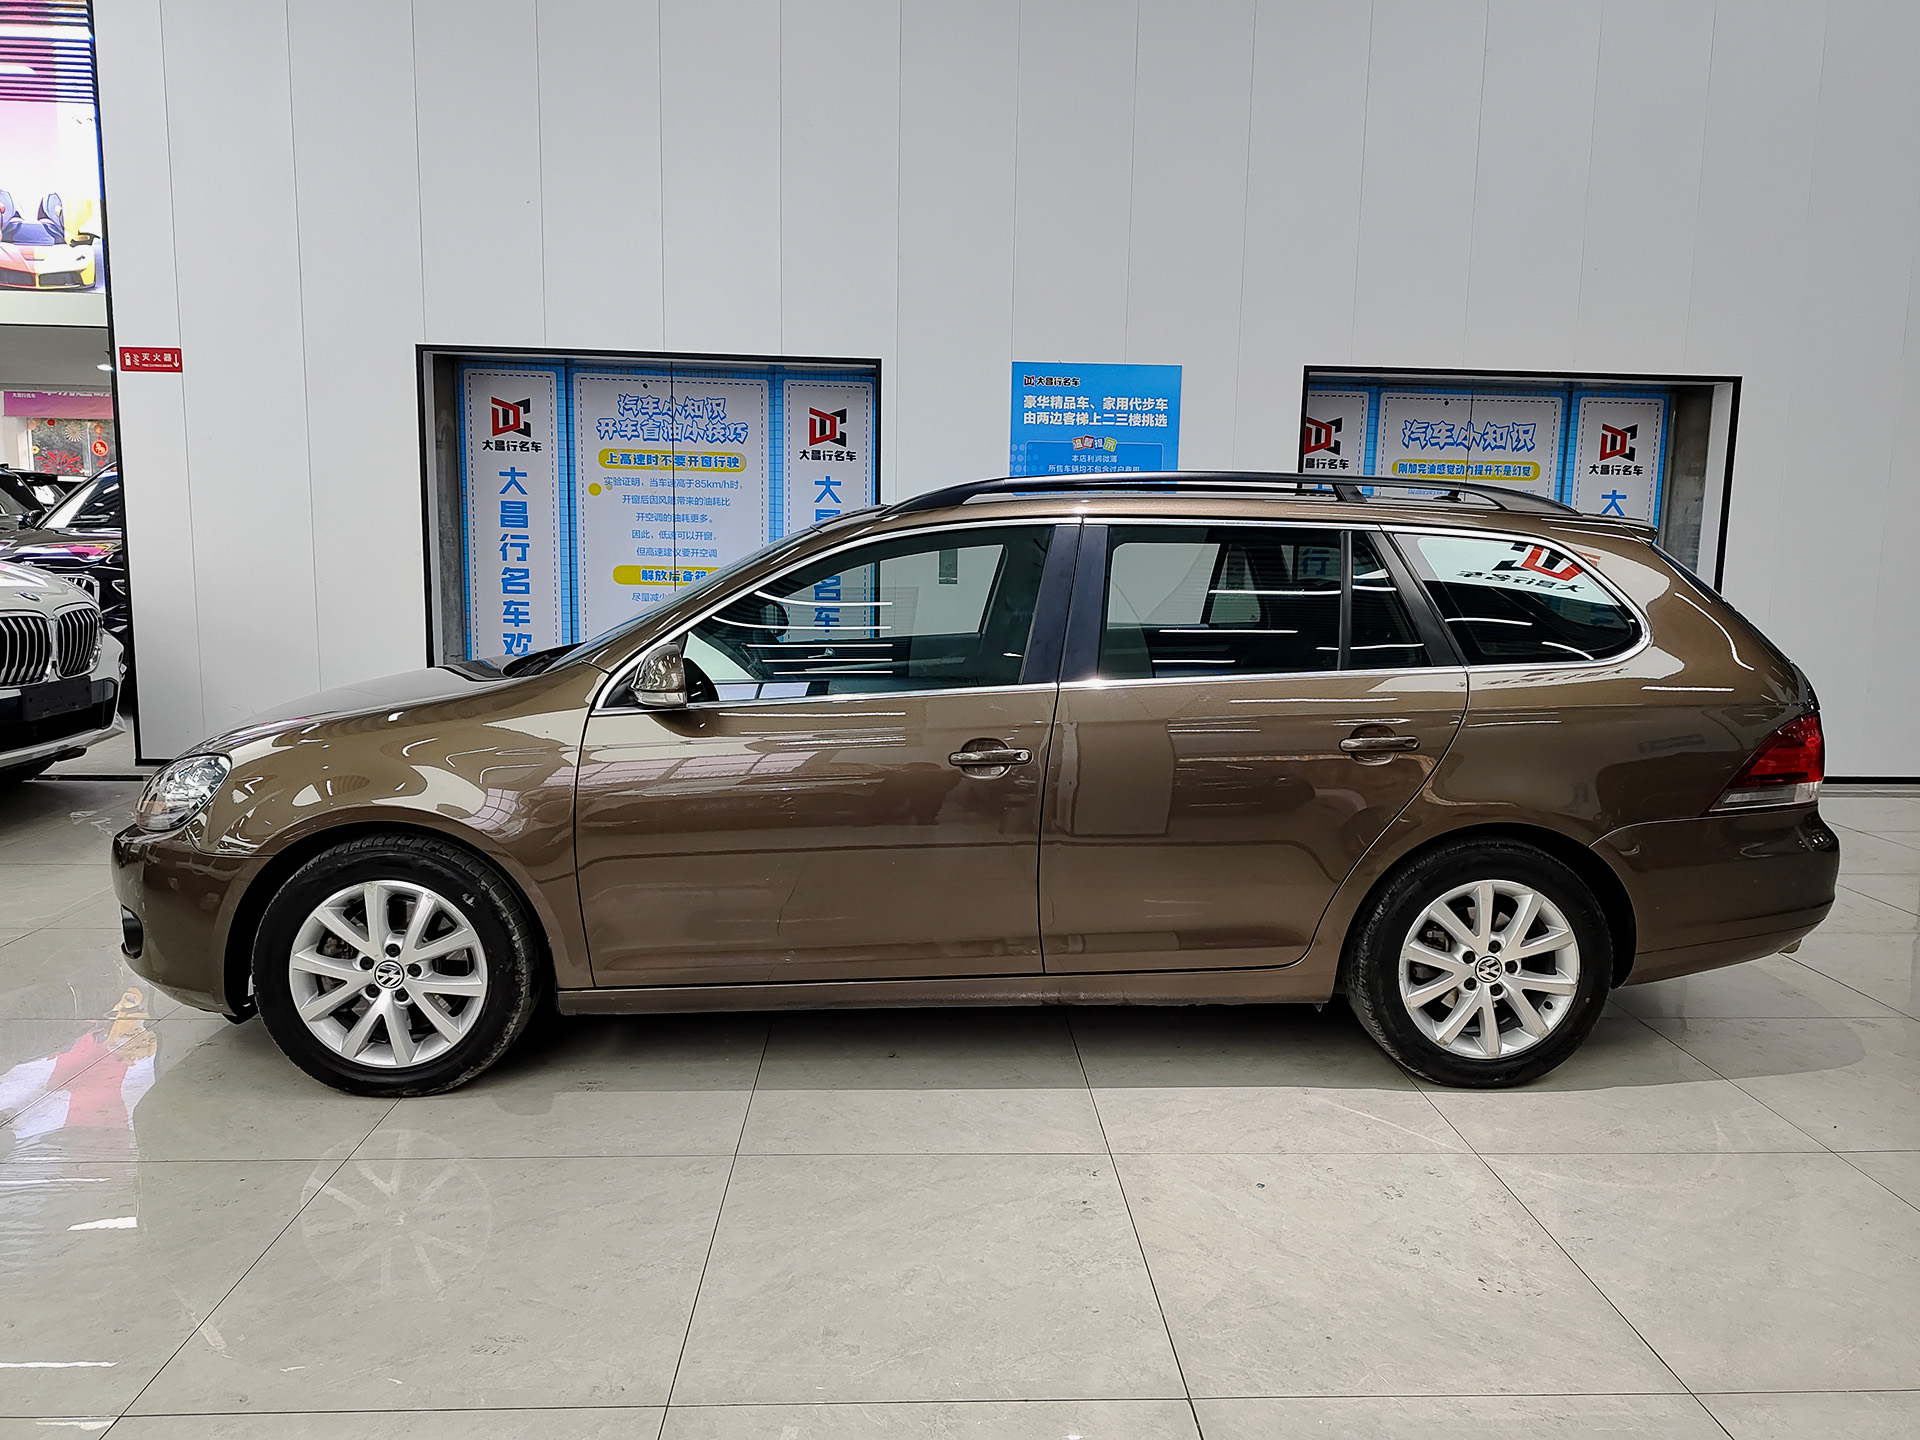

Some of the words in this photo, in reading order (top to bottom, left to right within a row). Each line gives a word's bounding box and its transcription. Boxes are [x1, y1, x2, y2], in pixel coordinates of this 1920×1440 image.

[141, 352, 172, 362] 灭火器
[1036, 376, 1081, 387] 大昌行名车
[617, 393, 728, 421] 汽车小知识
[1023, 395, 1169, 411] 豪华精品车、家用代步车
[1023, 411, 1168, 427] 由两边客梯上二三楼挑选
[596, 417, 749, 445] 开车省油小技巧
[1402, 418, 1537, 452] 汽车小知识
[481, 439, 543, 453] 大昌行名车
[606, 452, 741, 469] 上高速时不要开窗行驶
[798, 449, 857, 462] 大昌行名车
[1398, 462, 1532, 477] 刚加完油感觉动力提升不是幻觉
[1588, 463, 1644, 476] 大昌行名车
[636, 546, 718, 558] 但高速建议要开空调
